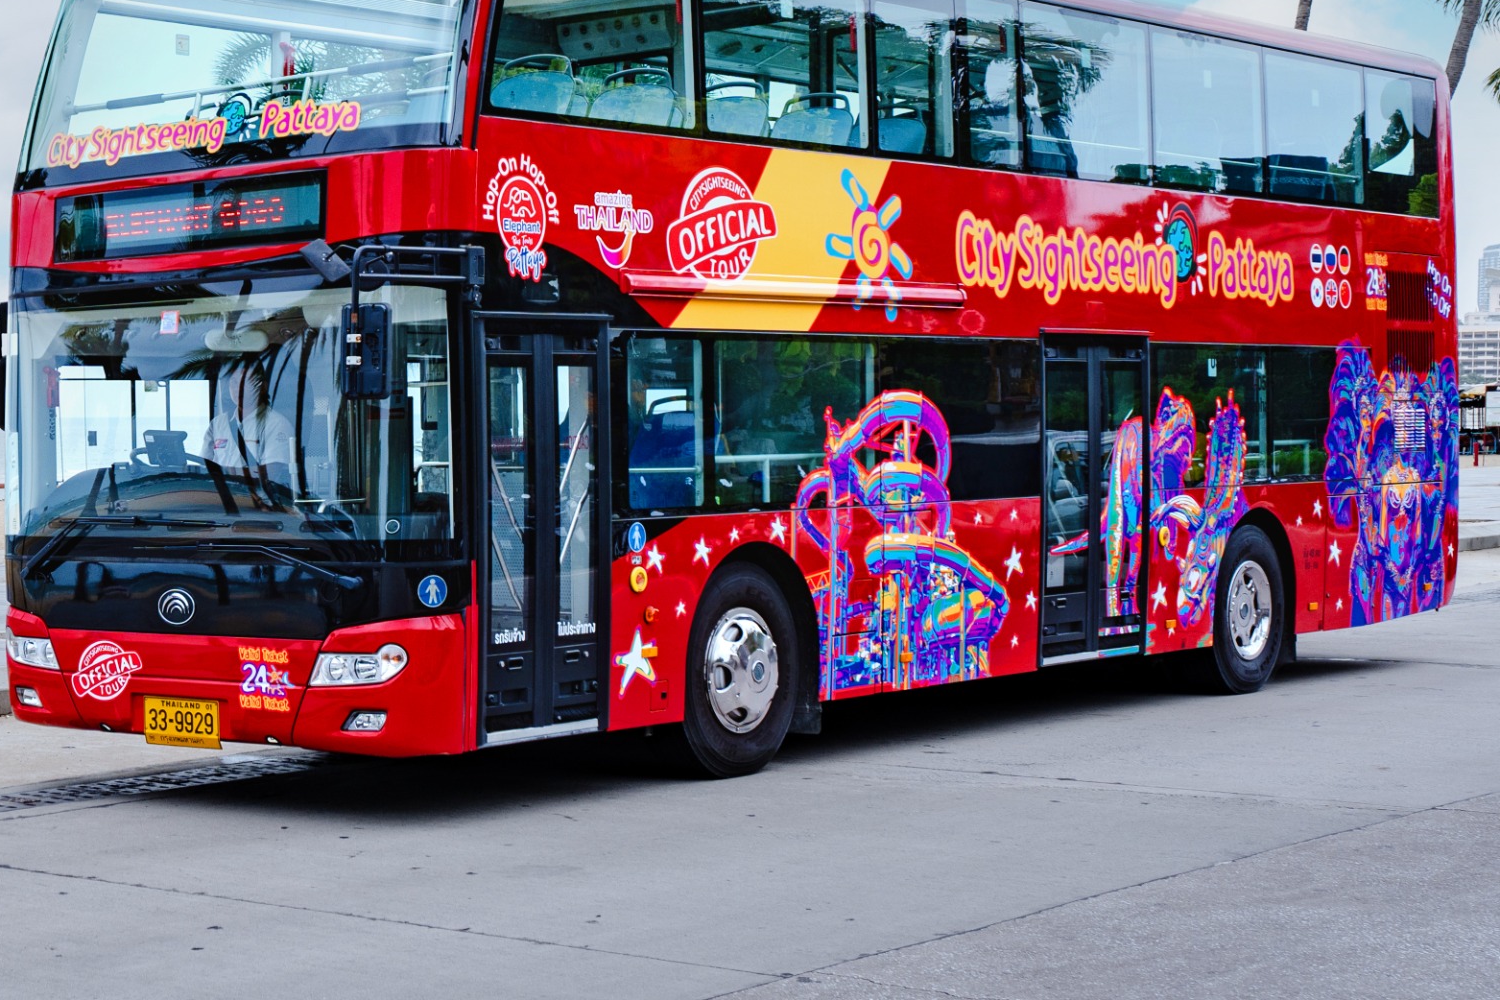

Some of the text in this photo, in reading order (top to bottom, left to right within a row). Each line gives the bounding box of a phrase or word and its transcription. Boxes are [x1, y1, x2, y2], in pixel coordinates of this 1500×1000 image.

[258, 100, 362, 139] Pattaya
[594, 191, 633, 208] amazing
[503, 218, 542, 235] Elephant
[574, 204, 654, 234] THAILAND
[678, 207, 771, 261] OFFICIAL
[506, 246, 546, 279] Pattaya
[709, 247, 751, 280] TOUR
[1207, 230, 1295, 307] Pattaya
[79, 654, 138, 690] OFFICIAL
[100, 676, 126, 695] TOUR
[242, 663, 270, 693] 24
[161, 700, 201, 709] THAILAND
[149, 708, 214, 735] 33-9929
